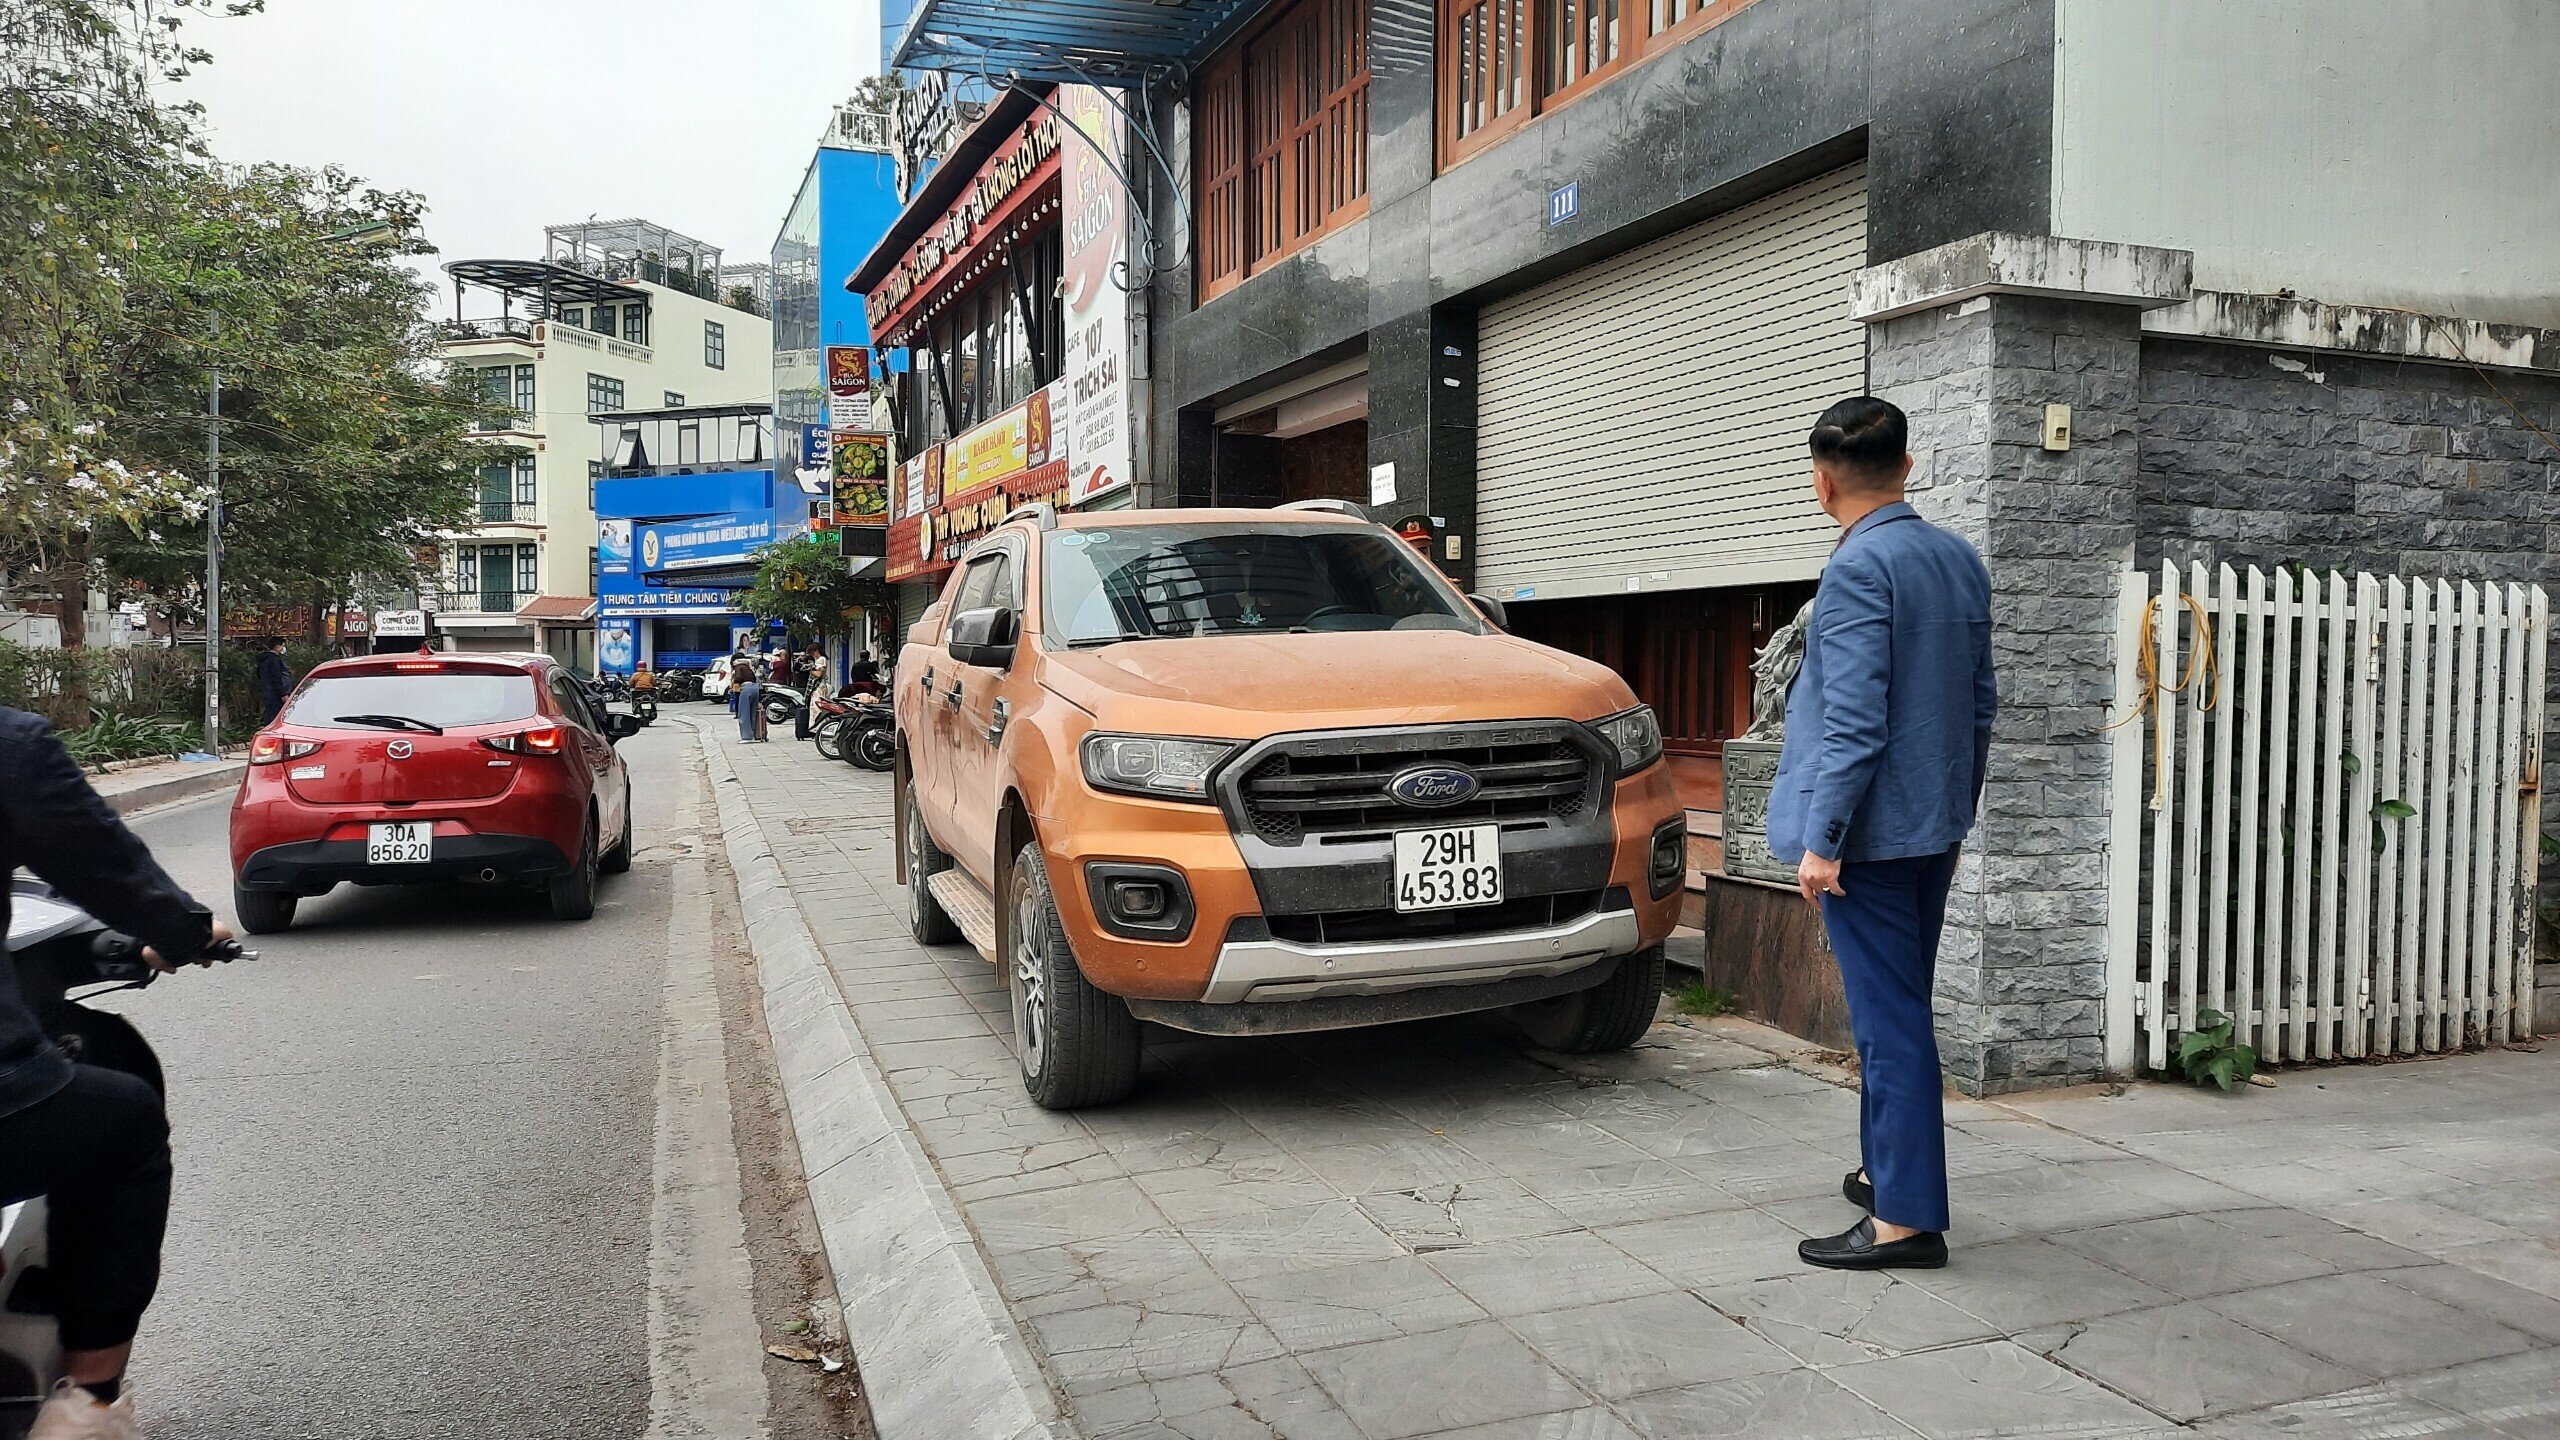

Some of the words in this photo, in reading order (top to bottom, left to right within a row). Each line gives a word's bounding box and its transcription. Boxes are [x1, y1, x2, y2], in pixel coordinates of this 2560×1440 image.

[1084, 171, 1098, 204] BIA
[1553, 189, 1573, 218] 111
[1071, 181, 1114, 258] SAIGON
[1085, 317, 1103, 362] 107
[832, 378, 866, 386] SAIGON
[1074, 365, 1101, 408] TRÍCH
[1102, 349, 1118, 390] SÀI
[603, 594, 634, 605] TRUNG
[637, 592, 657, 604] TÂM
[659, 591, 682, 604] TIÊM
[685, 589, 718, 604] CHỦNG
[405, 615, 419, 625] G87
[1414, 776, 1458, 797] Ford
[384, 825, 416, 842] 30A
[1420, 829, 1475, 867] 29H
[371, 843, 429, 861] 856.20
[1401, 866, 1498, 906] 453.83
